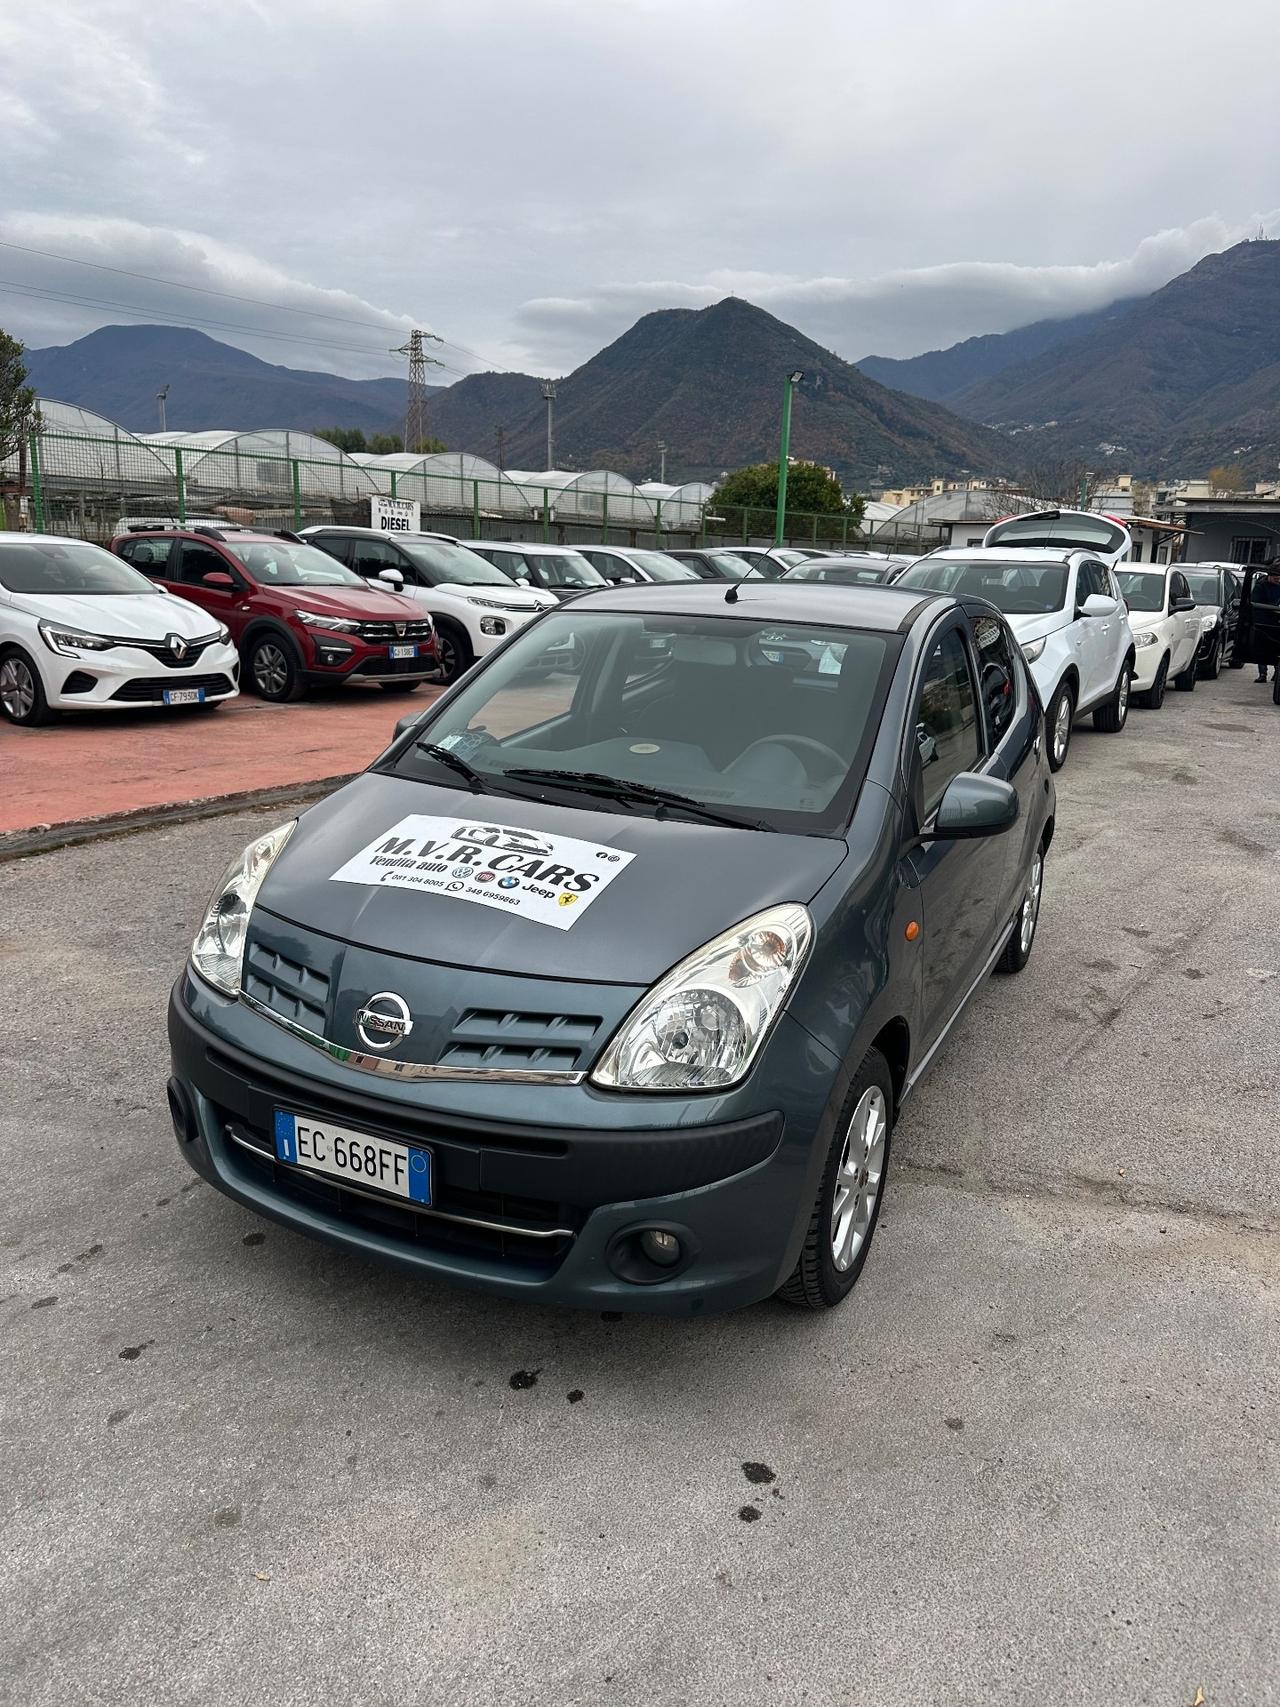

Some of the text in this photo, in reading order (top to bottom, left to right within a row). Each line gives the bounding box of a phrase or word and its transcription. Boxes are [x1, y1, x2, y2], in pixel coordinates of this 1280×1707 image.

[381, 516, 411, 531] DIESEL
[369, 855, 449, 873] Vendita auto
[374, 837, 600, 892] M.V.R. CARS
[423, 879, 445, 888] 8005
[522, 883, 556, 899] Jeep
[465, 886, 521, 906] 349 6959863
[357, 1010, 406, 1033] NISSAN
